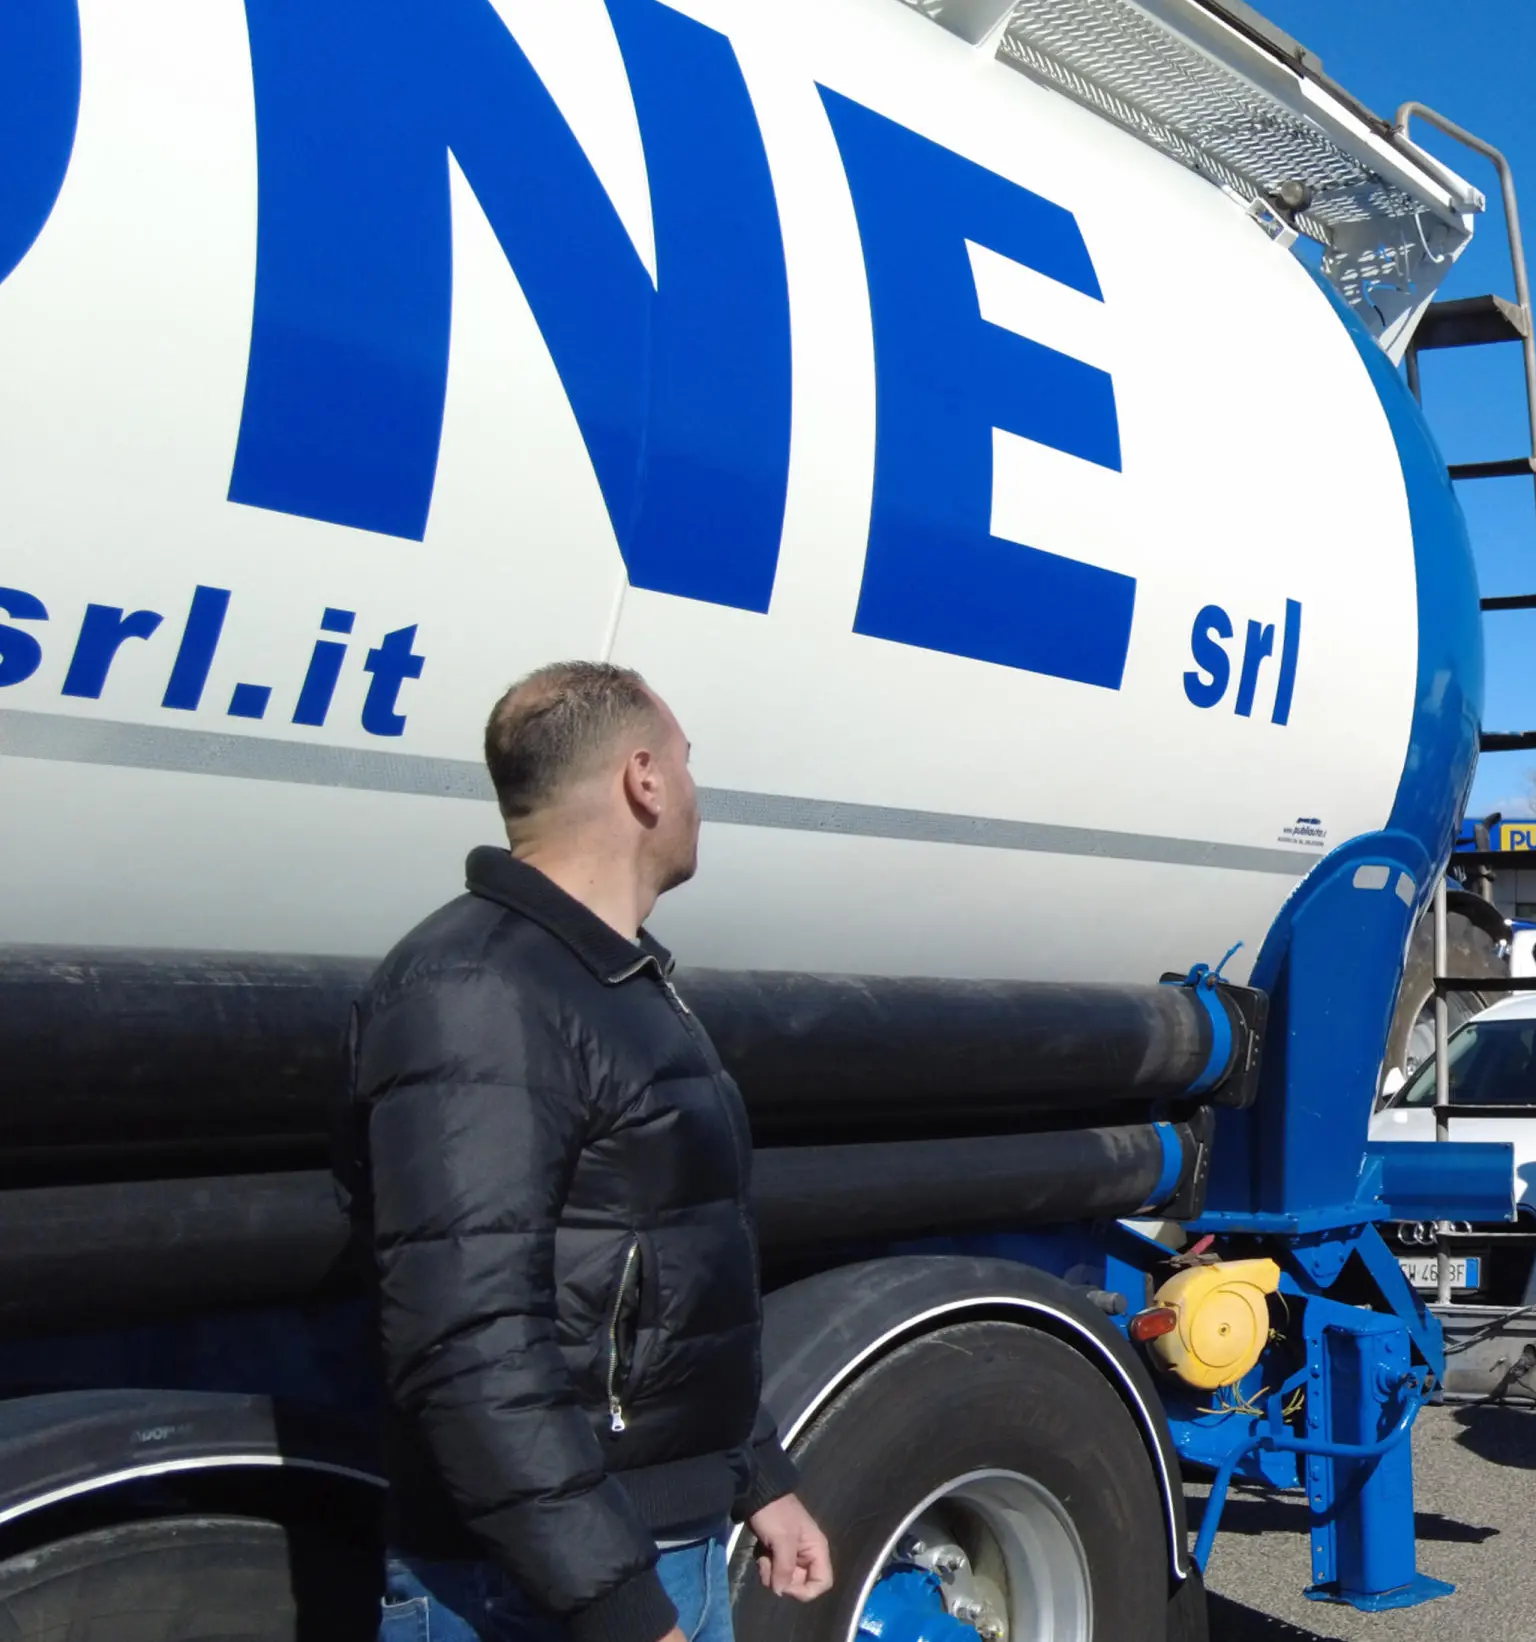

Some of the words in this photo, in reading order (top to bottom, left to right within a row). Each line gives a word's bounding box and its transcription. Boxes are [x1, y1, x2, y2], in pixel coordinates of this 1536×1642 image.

[0, 0, 1137, 692] NE
[1183, 598, 1301, 726] srl
[1421, 1264, 1465, 1282] 46BF
